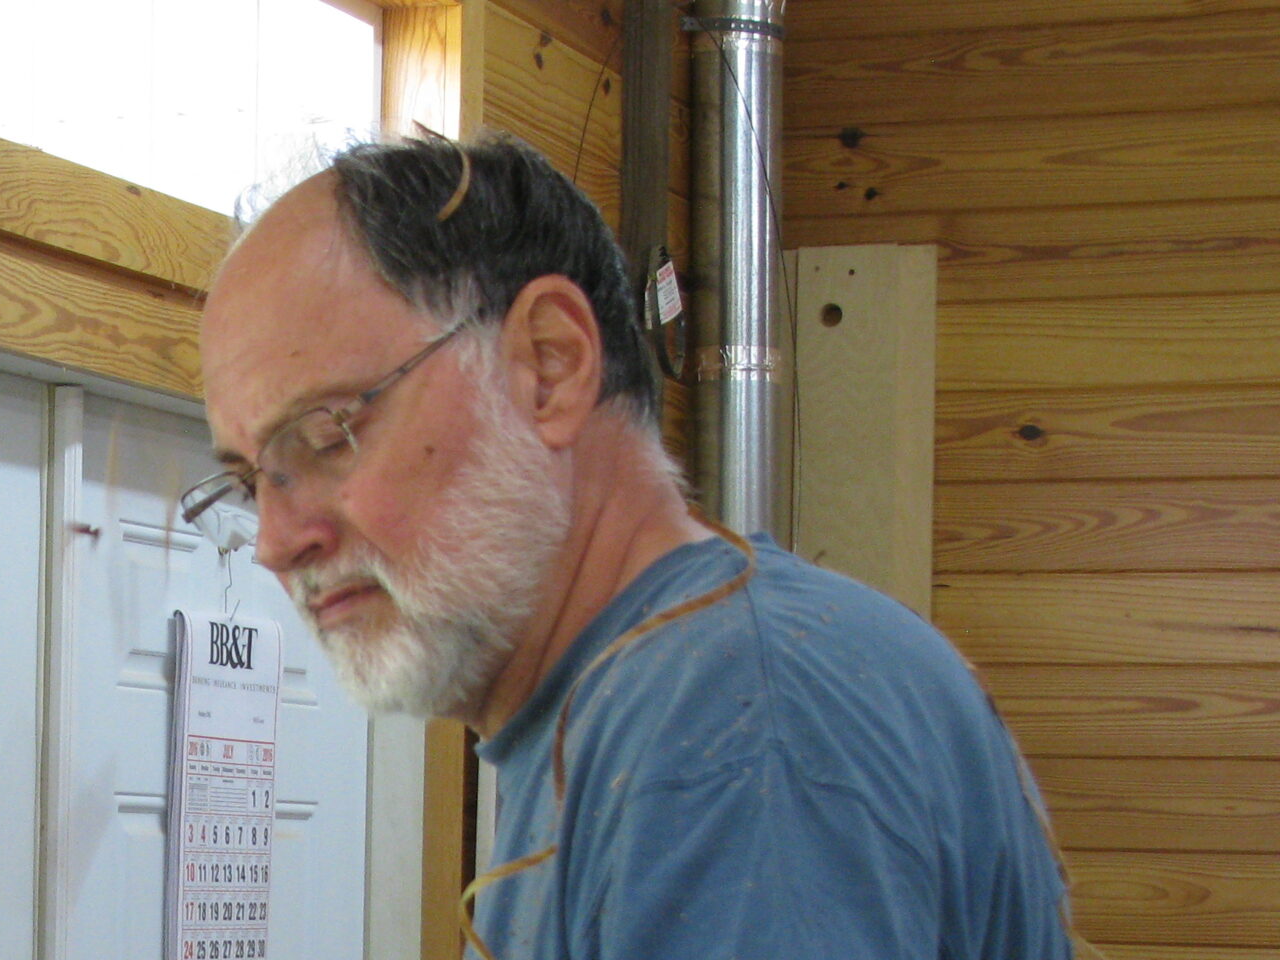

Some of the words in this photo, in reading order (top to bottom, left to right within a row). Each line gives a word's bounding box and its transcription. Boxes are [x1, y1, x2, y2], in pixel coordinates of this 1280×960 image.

[208, 621, 258, 670] BB&T
[241, 683, 276, 694] INVESTMENTS
[252, 790, 256, 807] 1
[264, 790, 270, 808] 2
[188, 824, 194, 843] 3
[200, 824, 206, 843] 4
[212, 825, 218, 844] 5
[224, 826, 230, 844] 6
[238, 826, 242, 844] 7
[252, 827, 257, 846] 8
[264, 827, 268, 846] 9
[186, 863, 194, 882] 10
[198, 864, 206, 882] 11
[211, 864, 220, 882] 12
[223, 864, 232, 882] 13
[236, 864, 246, 882] 14
[250, 864, 258, 882] 15
[261, 866, 268, 882] 16
[185, 902, 194, 920] 17
[198, 902, 206, 920] 18
[210, 902, 219, 920] 19
[222, 902, 232, 920] 20
[236, 902, 244, 920] 21
[248, 902, 256, 920] 22
[259, 902, 266, 920] 23
[184, 940, 193, 960] 24
[196, 940, 206, 960] 25
[210, 940, 220, 959] 26
[222, 940, 232, 959] 27
[235, 940, 244, 958] 28
[247, 940, 256, 958] 29
[258, 940, 265, 958] 30
